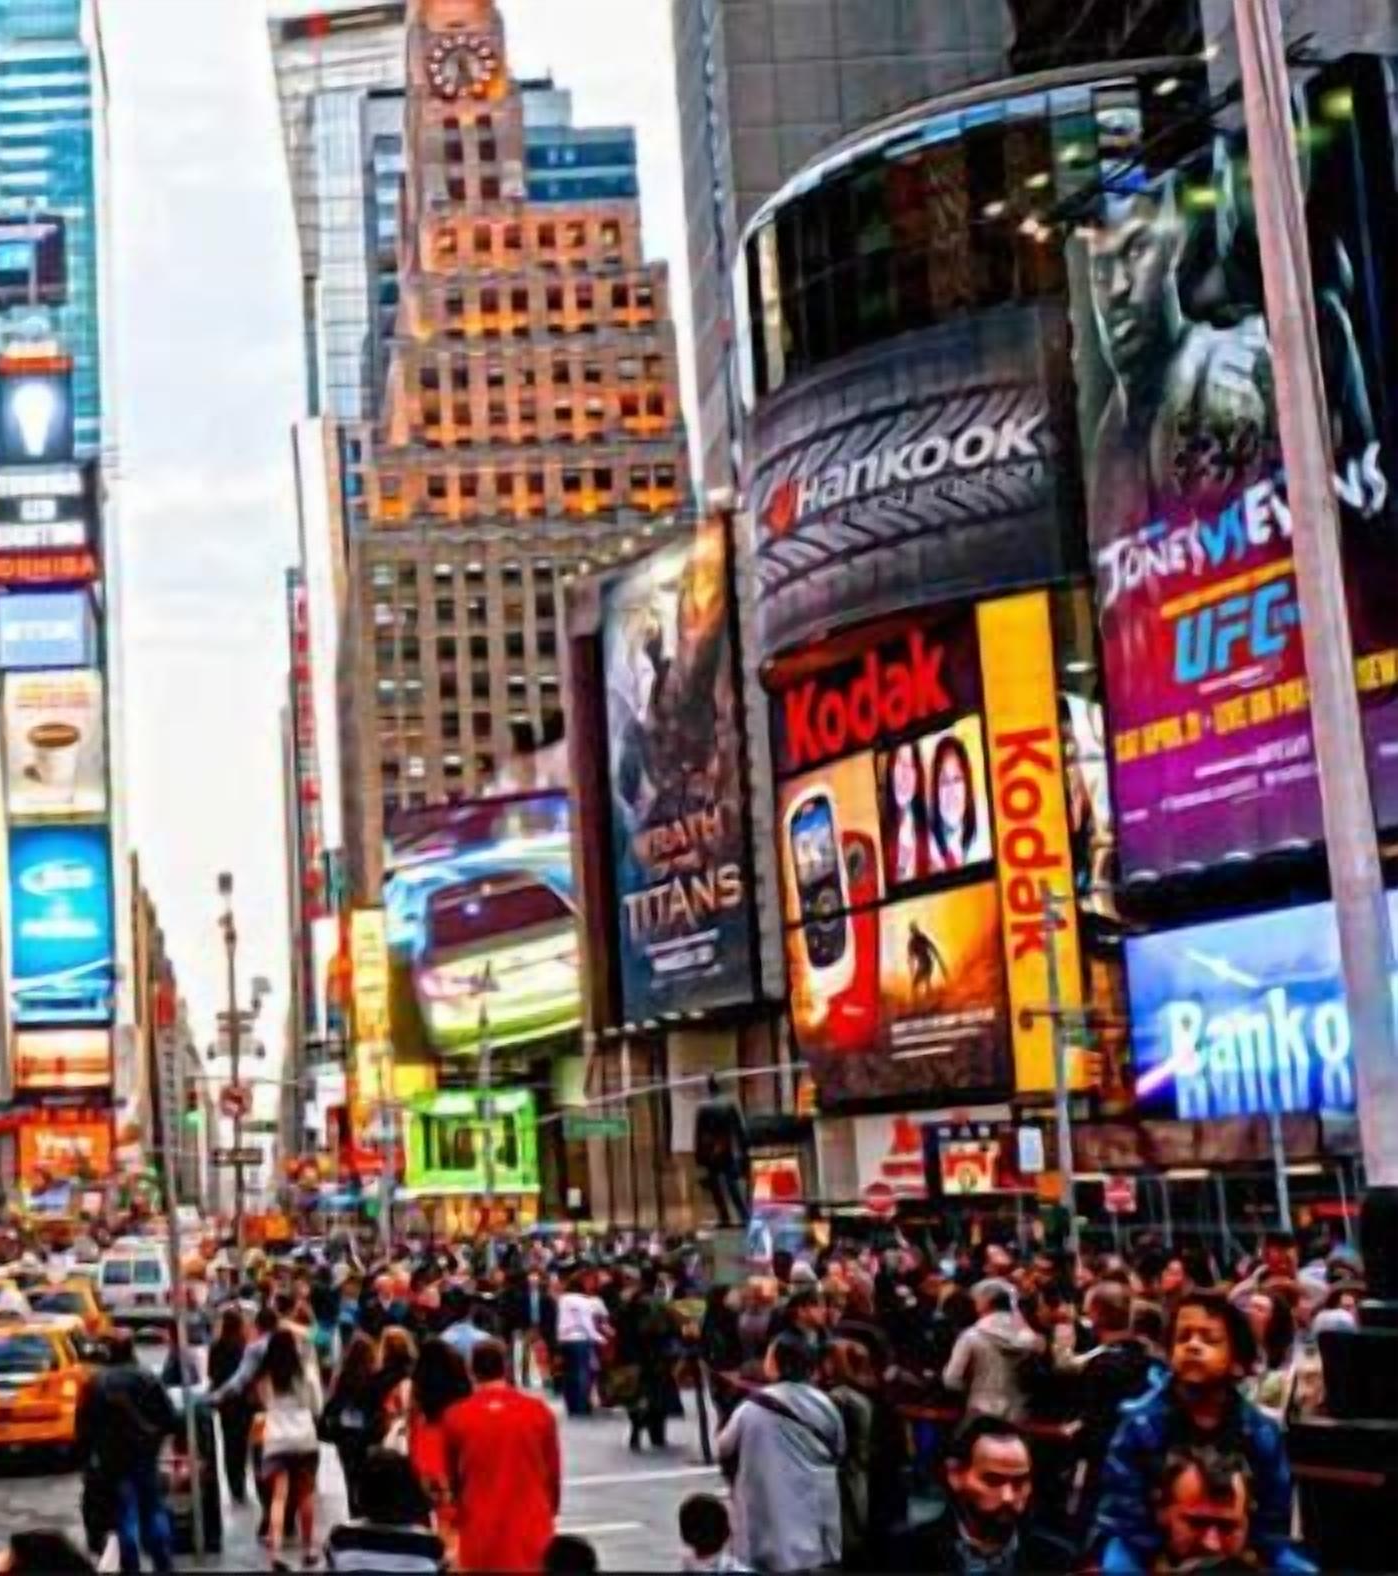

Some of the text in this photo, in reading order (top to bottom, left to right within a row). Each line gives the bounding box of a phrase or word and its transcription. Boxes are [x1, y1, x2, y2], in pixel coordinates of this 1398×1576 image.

[1173, 582, 1290, 683] UFC
[783, 627, 951, 765] Kodak
[622, 863, 743, 945] TITANS
[996, 728, 1067, 961] Kodak
